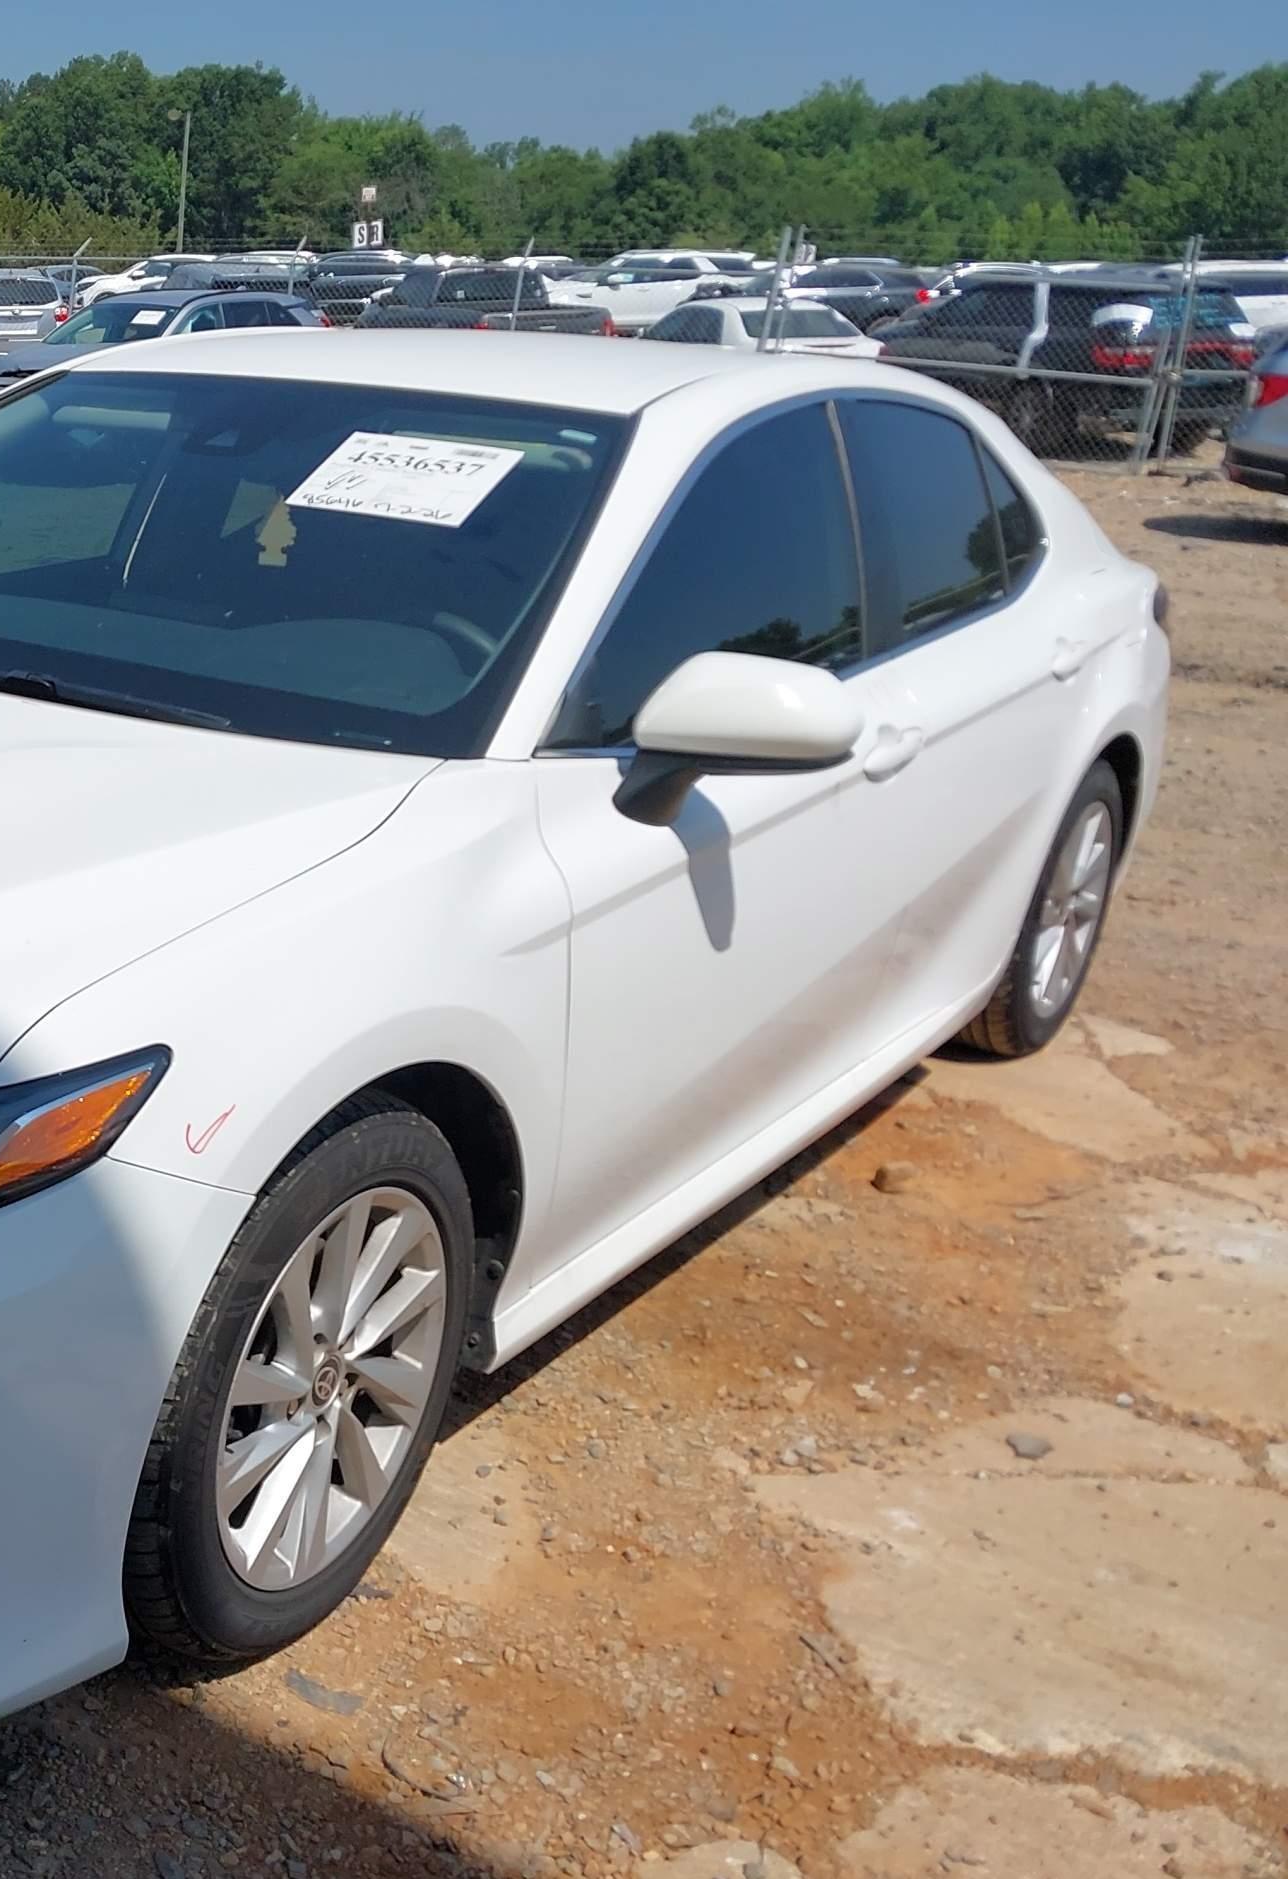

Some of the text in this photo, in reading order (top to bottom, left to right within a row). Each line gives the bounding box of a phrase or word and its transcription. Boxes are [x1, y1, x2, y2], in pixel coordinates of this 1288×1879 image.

[357, 224, 379, 244] S R
[347, 450, 486, 477] 45536537
